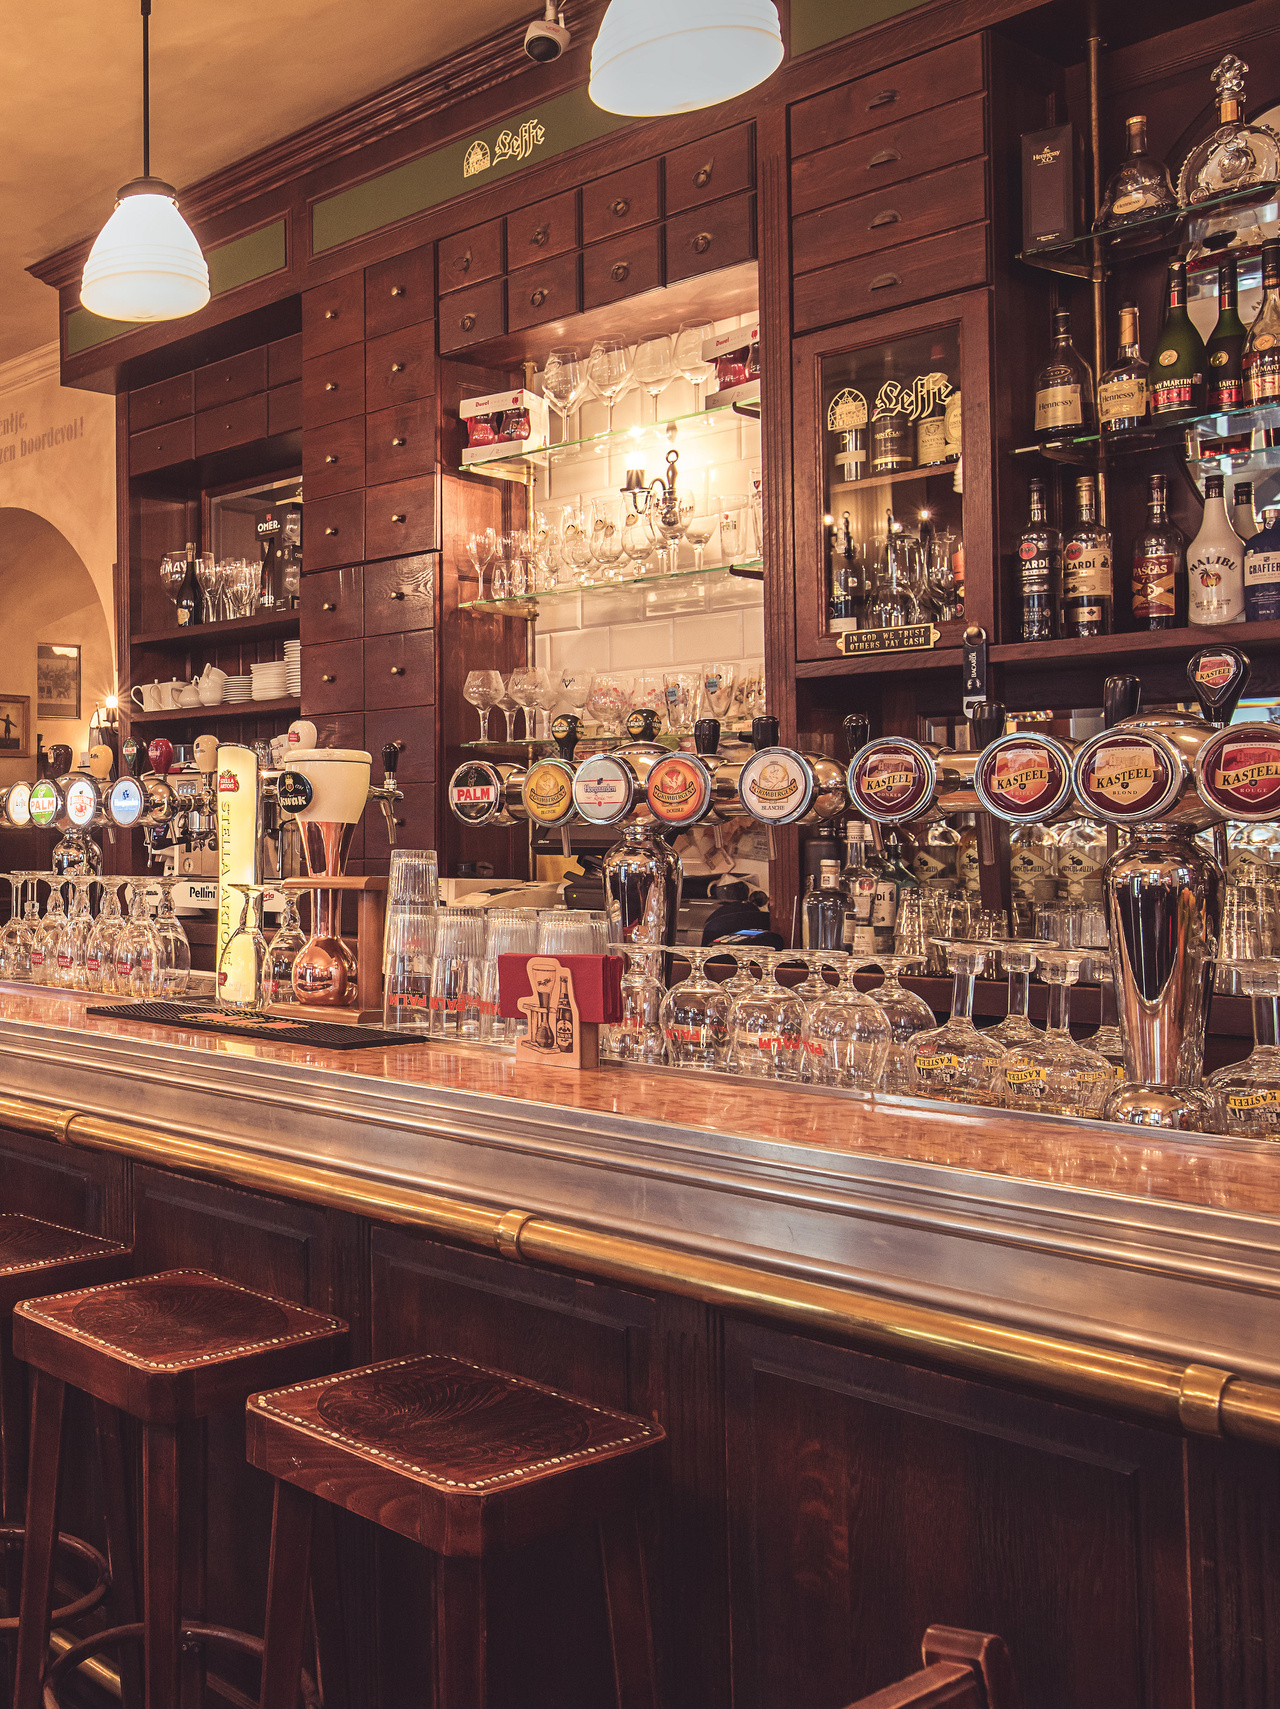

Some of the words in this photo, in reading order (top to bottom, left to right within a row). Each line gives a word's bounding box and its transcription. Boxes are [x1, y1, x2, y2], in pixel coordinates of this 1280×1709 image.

[492, 118, 546, 166] Leffe
[1032, 149, 1061, 161] Hennessy
[475, 400, 490, 408] Duvel
[871, 372, 953, 422] Leffe
[1102, 391, 1135, 404] Hennessy
[1038, 399, 1074, 411] Hennessy
[1133, 564, 1168, 576] PASCAS
[1189, 555, 1238, 575] MALIBU
[849, 634, 858, 643] IN
[862, 633, 877, 642] GOD
[882, 631, 894, 640] WE
[898, 628, 925, 638] TRUST
[849, 640, 880, 651] OTHERS
[885, 639, 900, 648] PAY
[903, 636, 925, 646] CASH
[1199, 667, 1232, 681] KASTEEL
[866, 773, 911, 790] KASTEEL
[997, 769, 1047, 790] KASTEEL
[1096, 767, 1152, 789] KASTEEL
[456, 787, 490, 801] PALM
[656, 789, 693, 801] GRIMBERGEN
[753, 785, 794, 798] GRIMBERGEN
[30, 799, 55, 811] PALM
[221, 800, 231, 876] STELLA
[189, 886, 216, 899] Pellini
[389, 993, 427, 1007] PALM
[758, 1037, 800, 1050] PALM
[917, 1056, 952, 1068] KASTEEL
[1007, 1070, 1041, 1081] KASTEEL
[1230, 1091, 1278, 1107] KASTEEL
